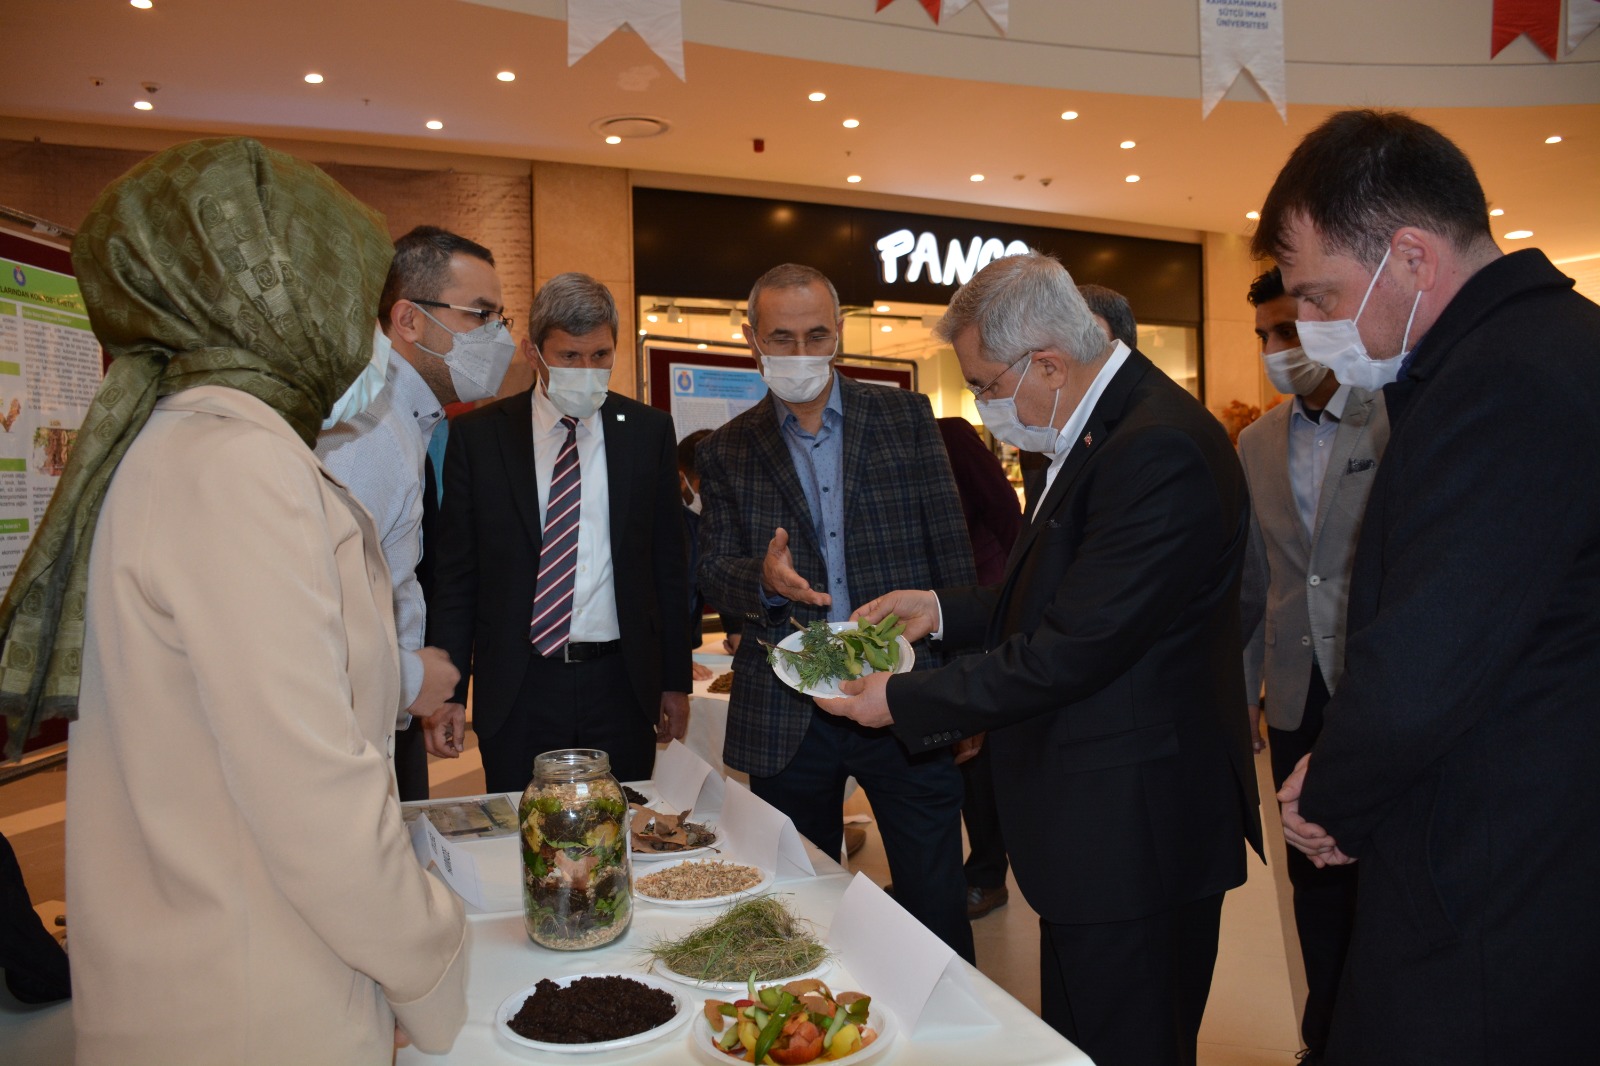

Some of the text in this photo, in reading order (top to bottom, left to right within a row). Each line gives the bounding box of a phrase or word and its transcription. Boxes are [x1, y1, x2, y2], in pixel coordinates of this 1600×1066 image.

[1218, 8, 1266, 18] SÜTÇÜ İMAM
[1216, 17, 1269, 29] ÜNİVERSİTESİ
[0, 286, 30, 299] LARINDAN
